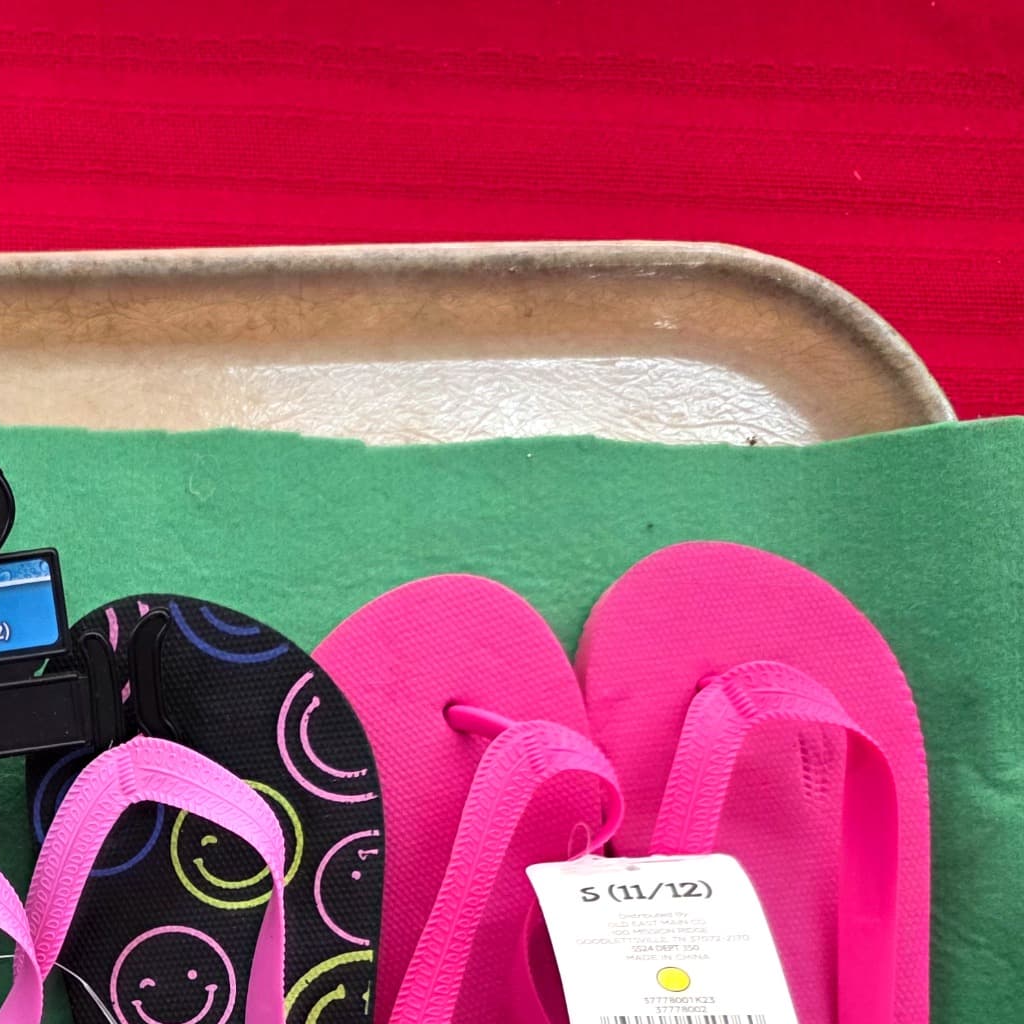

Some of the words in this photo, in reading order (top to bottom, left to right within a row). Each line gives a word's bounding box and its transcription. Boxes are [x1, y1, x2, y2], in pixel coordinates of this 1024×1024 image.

[580, 887, 600, 903] S
[608, 880, 712, 902] (11/12)
[655, 944, 679, 952] DEPT
